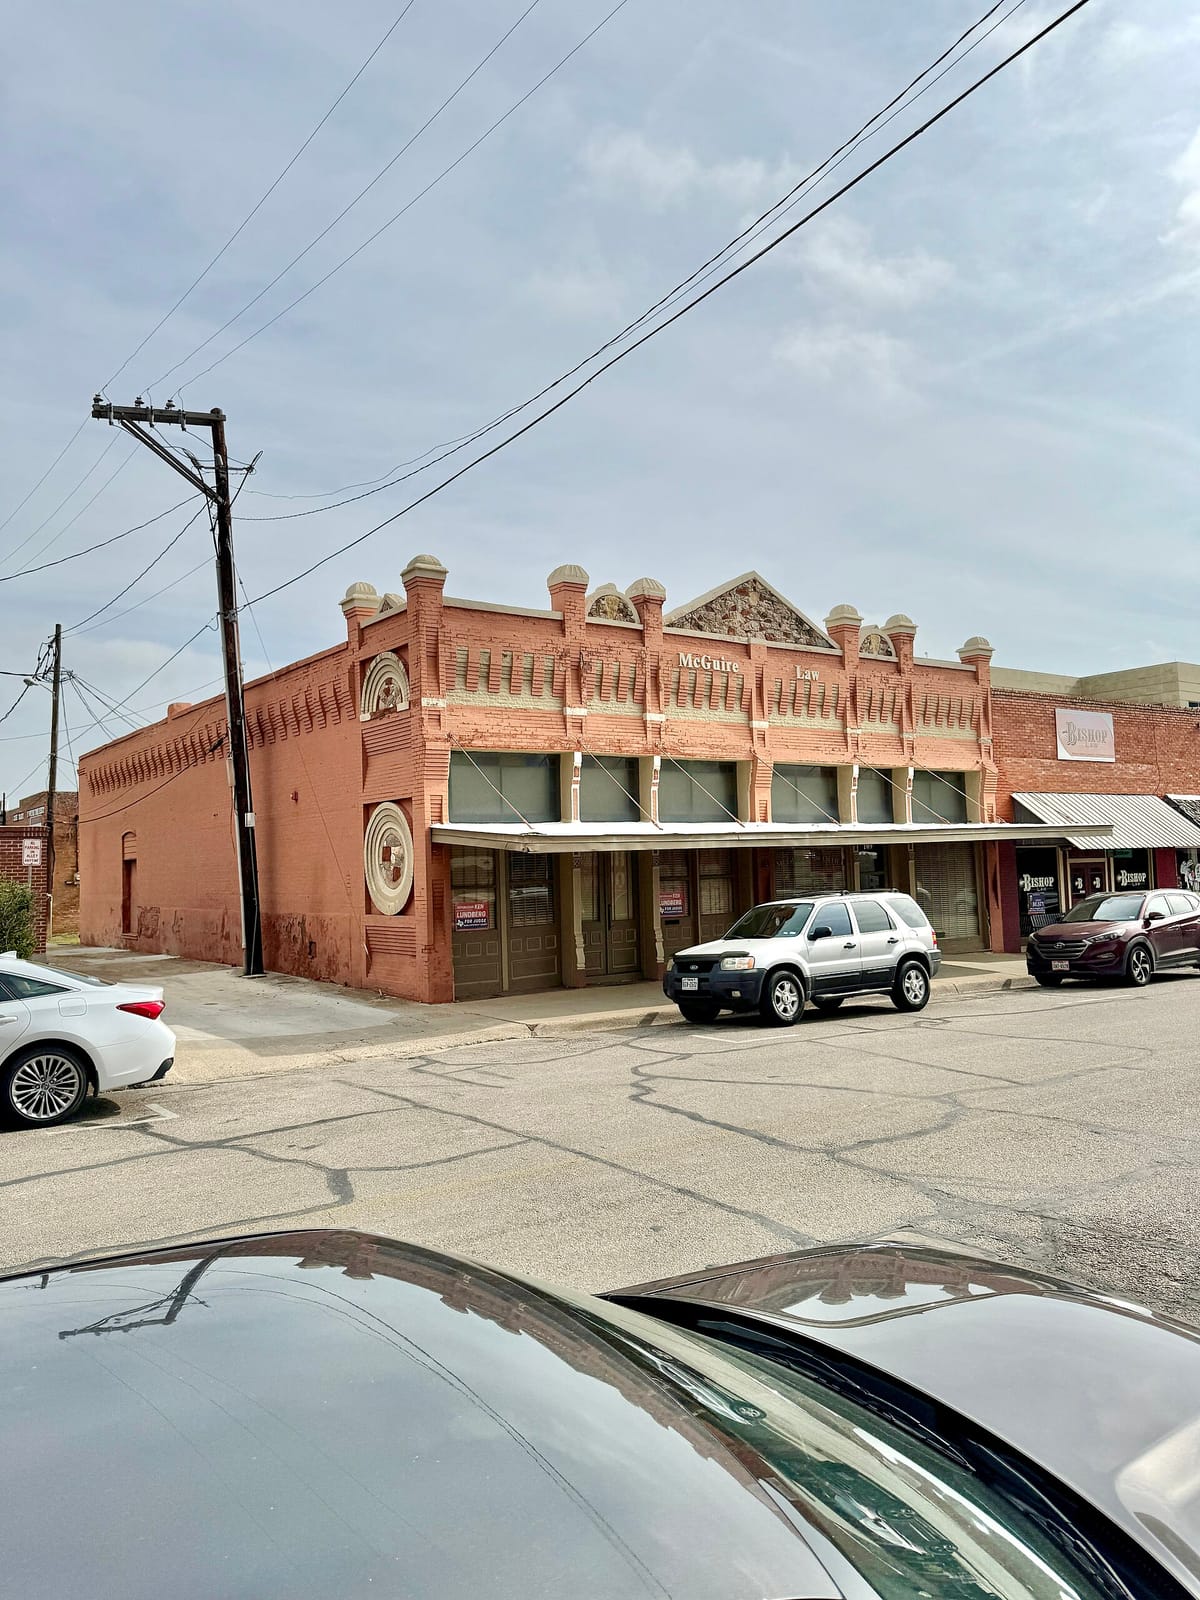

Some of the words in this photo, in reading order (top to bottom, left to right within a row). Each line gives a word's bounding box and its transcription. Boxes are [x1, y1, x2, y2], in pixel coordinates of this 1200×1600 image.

[678, 652, 739, 673] McGuire
[795, 665, 820, 681] Law
[1020, 874, 1055, 891] BISHOP
[1117, 870, 1147, 886] BISHOP
